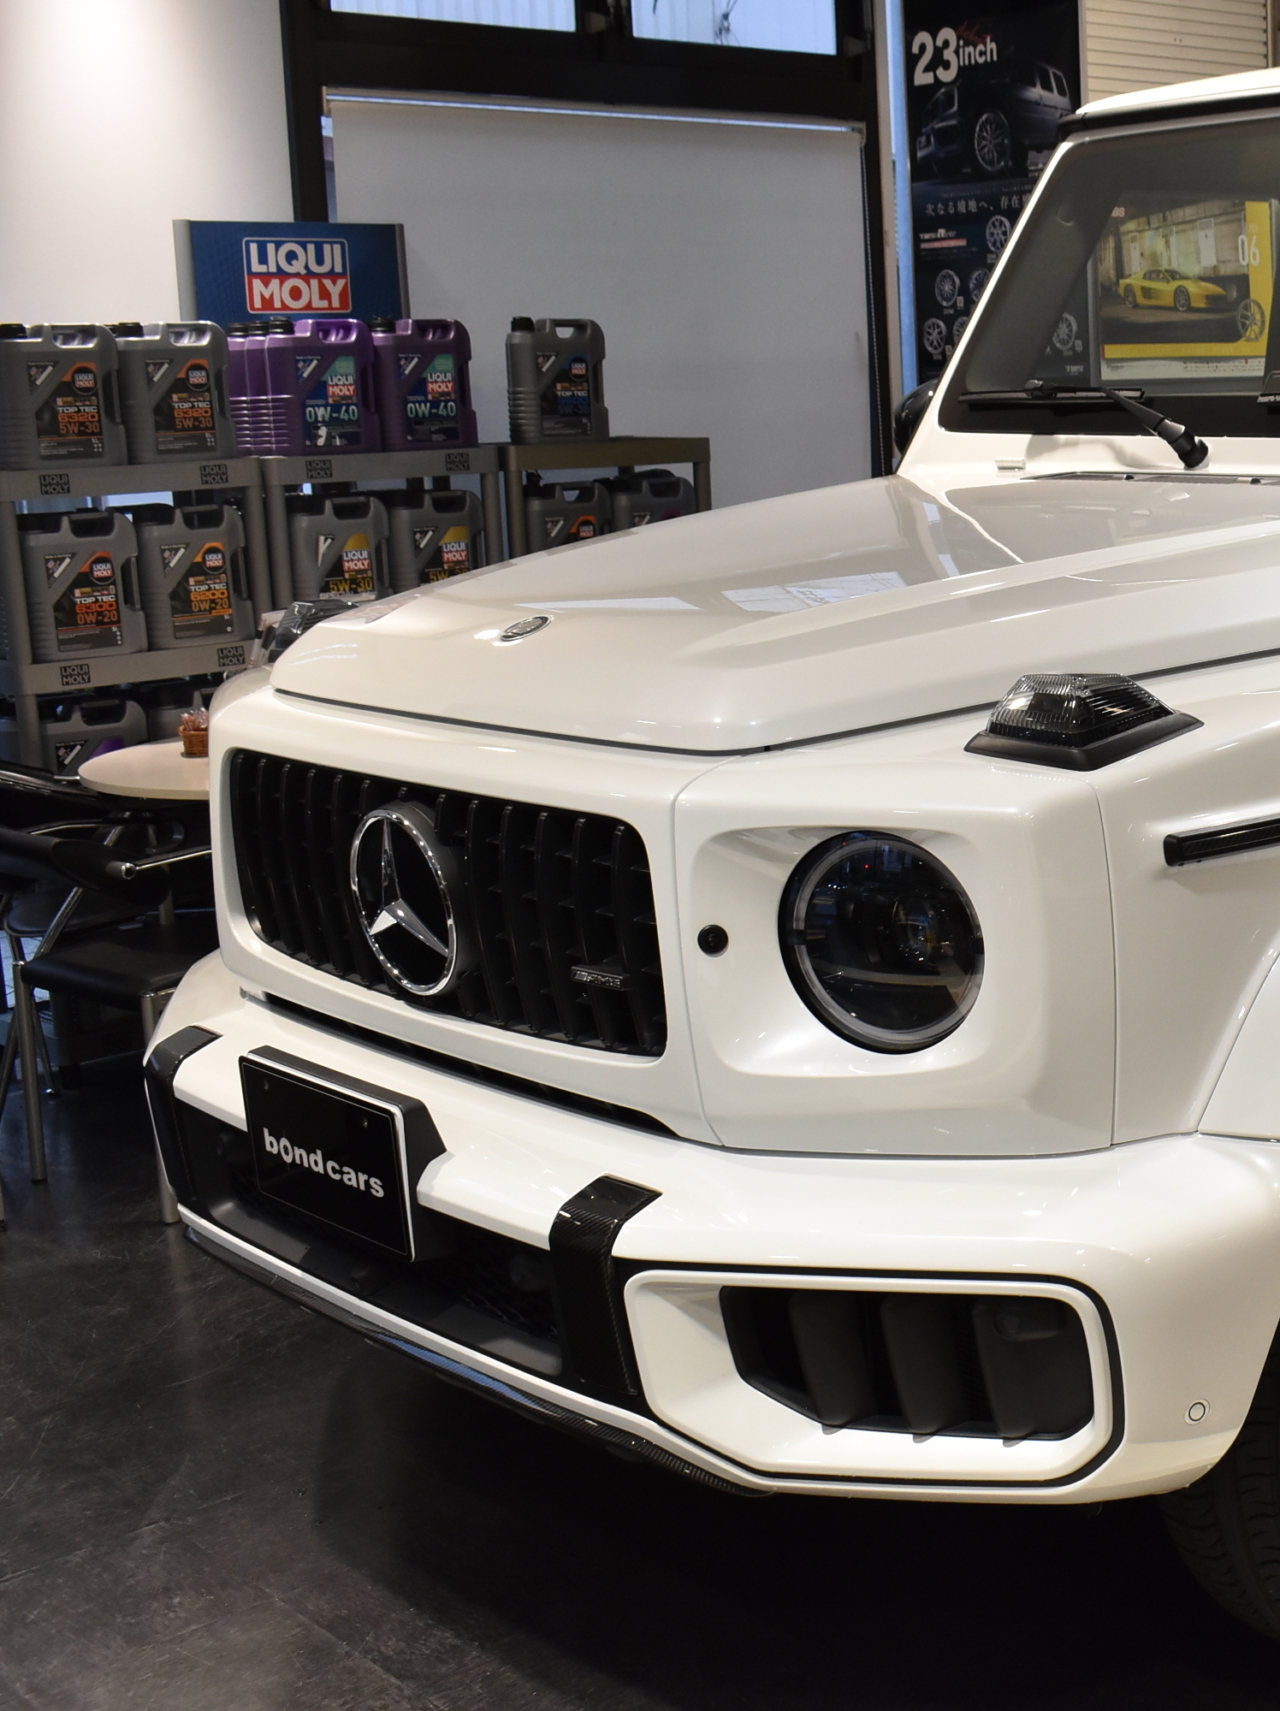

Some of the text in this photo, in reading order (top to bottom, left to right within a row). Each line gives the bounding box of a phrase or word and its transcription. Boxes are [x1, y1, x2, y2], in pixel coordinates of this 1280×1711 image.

[250, 242, 343, 275] LIQUI
[252, 278, 347, 309] MOLY
[328, 375, 354, 385] LIQUI
[428, 372, 452, 382] LIQUI
[329, 385, 355, 395] MOLY
[428, 382, 453, 393] MOLY
[79, 405, 98, 413] TEC
[174, 408, 212, 418] 6320
[305, 405, 359, 423] 0W-40
[406, 401, 457, 418] 0W-40
[58, 412, 99, 422] 6320
[175, 416, 213, 429] 5W-30
[59, 421, 100, 434] 5W-30
[201, 464, 226, 474] LIQUI
[41, 474, 68, 484] LIQUI
[202, 474, 227, 484] MOLY
[42, 484, 69, 495] MOLY
[443, 542, 466, 552] LIQUI
[343, 550, 369, 560] LIQUI
[444, 551, 467, 561] MOLY
[92, 562, 111, 570] LIQUI
[344, 560, 370, 571] MOLY
[329, 577, 373, 594] 5W-30
[75, 594, 116, 604] TOP TEC
[190, 589, 228, 601] 6200
[75, 601, 117, 613] 6300
[191, 598, 229, 612] 0W-20
[77, 610, 118, 624] 0W-20
[218, 646, 243, 657] LIQUI
[219, 656, 244, 666] MOLY
[62, 664, 89, 675] LIQUI
[63, 674, 90, 685] MOLY
